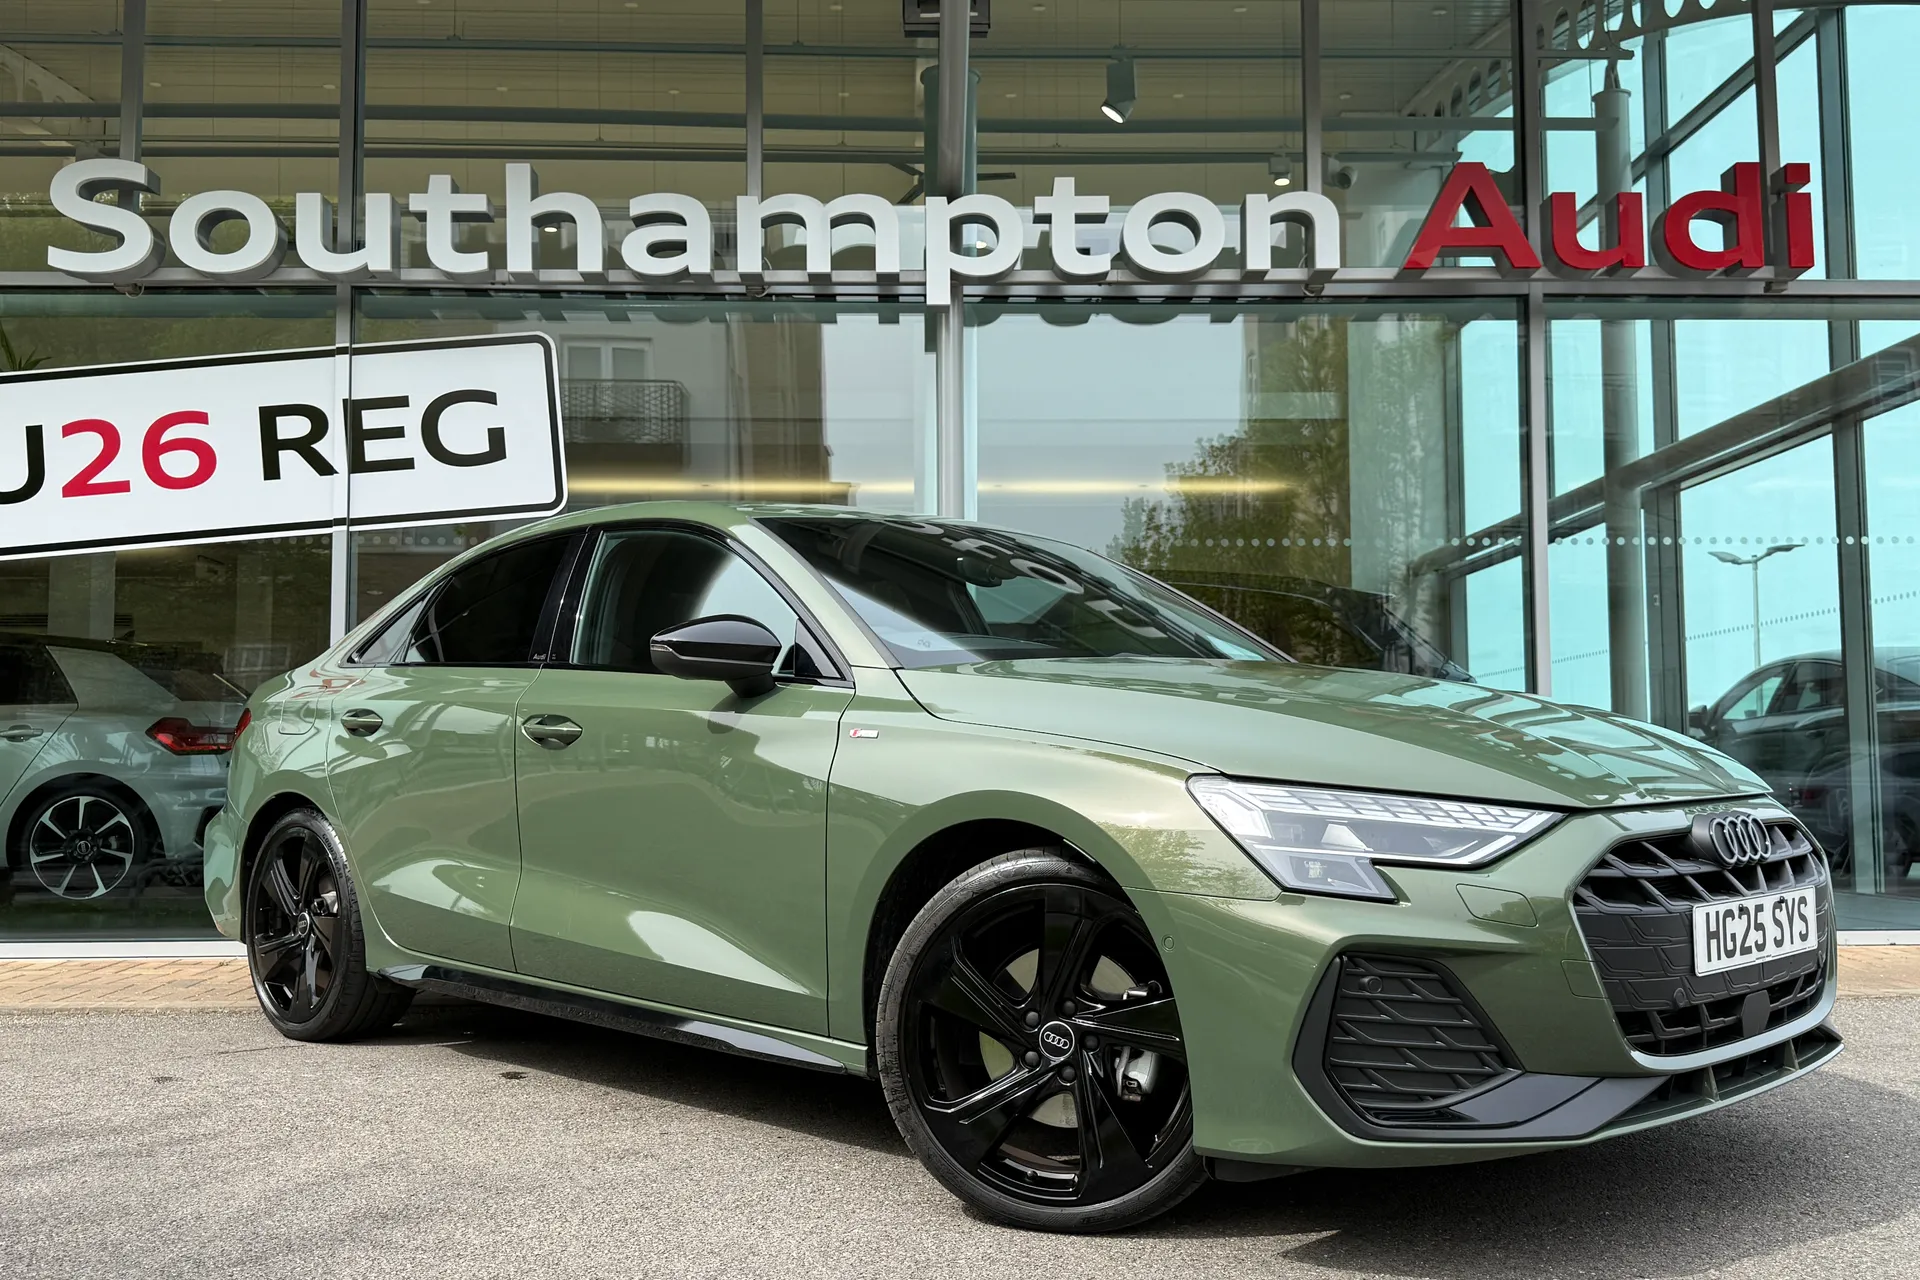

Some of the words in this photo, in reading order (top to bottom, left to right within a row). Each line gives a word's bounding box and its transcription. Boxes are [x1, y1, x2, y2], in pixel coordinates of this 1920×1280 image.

[48, 158, 1341, 305] Southampton
[1403, 161, 1815, 270] Audi
[258, 390, 507, 481] REG
[1705, 903, 1767, 963] HG25
[1772, 895, 1809, 948] SYS
